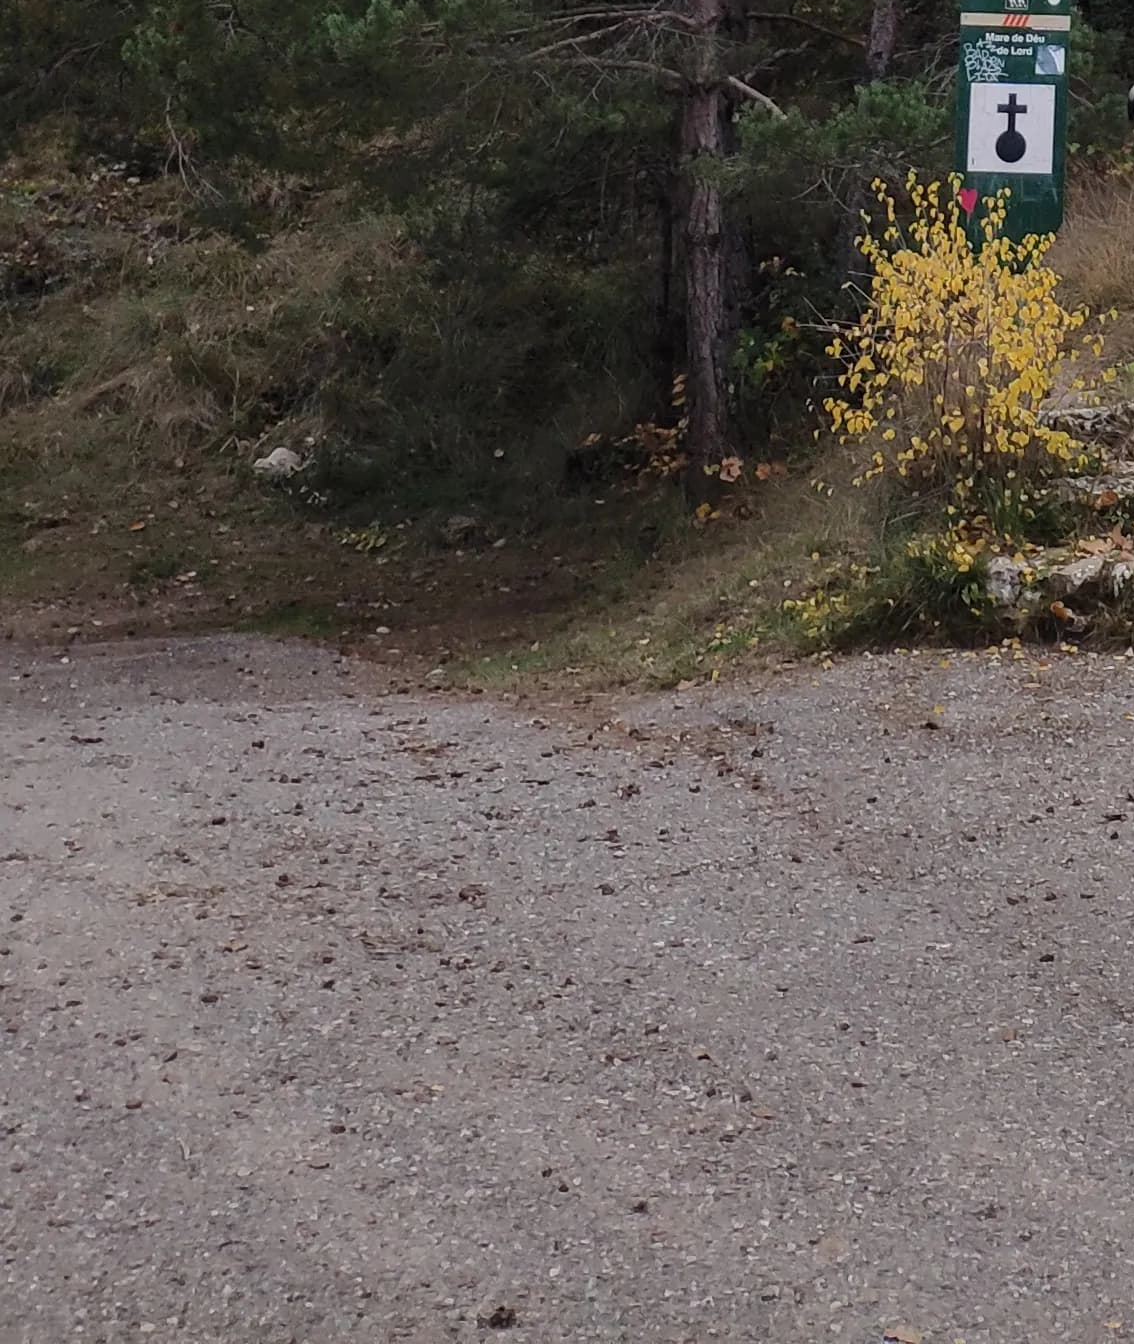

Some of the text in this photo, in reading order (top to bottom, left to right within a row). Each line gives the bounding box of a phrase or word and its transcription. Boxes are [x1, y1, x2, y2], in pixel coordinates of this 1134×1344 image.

[985, 32, 1046, 43] Mare de Déu
[996, 45, 1010, 56] de
[1010, 45, 1033, 56] Lord
